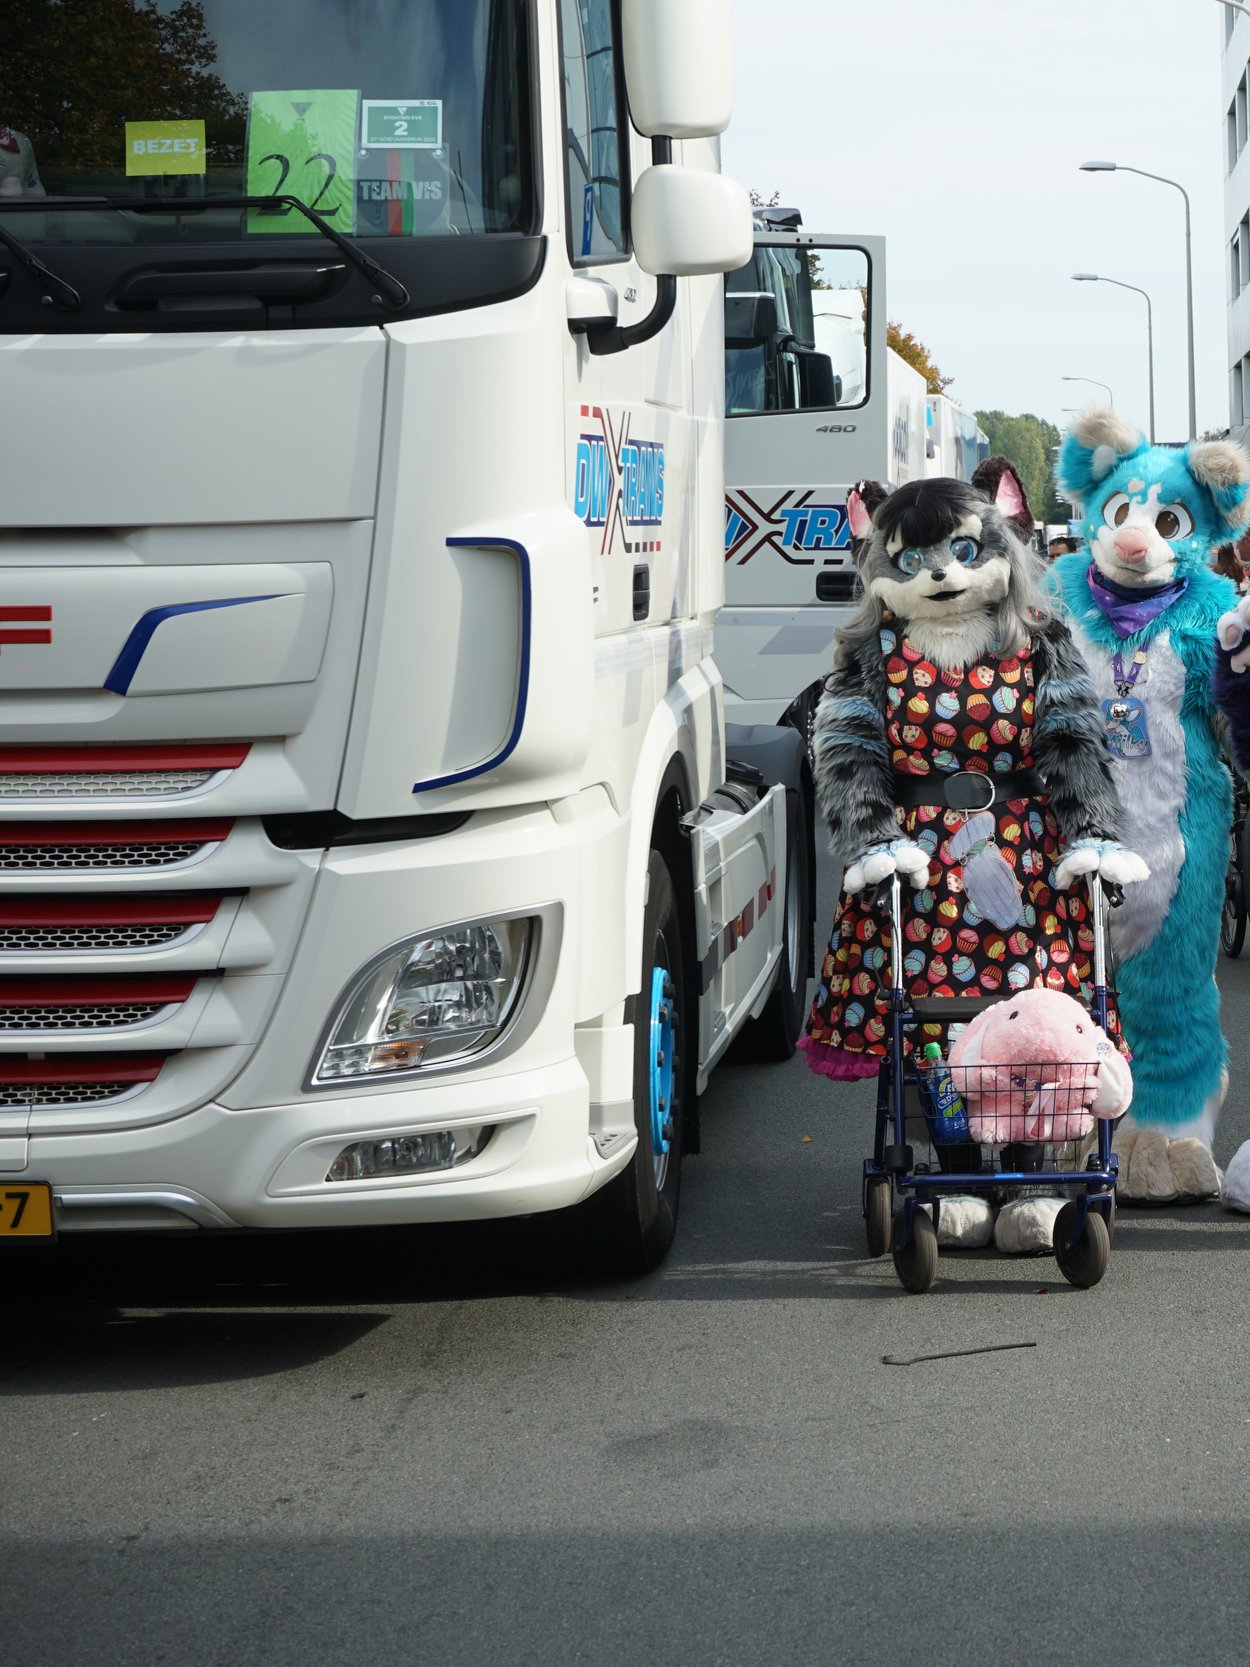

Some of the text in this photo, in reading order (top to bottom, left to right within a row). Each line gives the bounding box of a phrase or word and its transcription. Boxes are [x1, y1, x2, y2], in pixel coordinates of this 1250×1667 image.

[393, 121, 408, 136] 2
[132, 137, 199, 155] BEZET
[258, 153, 342, 217] 22
[359, 181, 442, 200] TEAM VIS
[815, 424, 857, 434] 480
